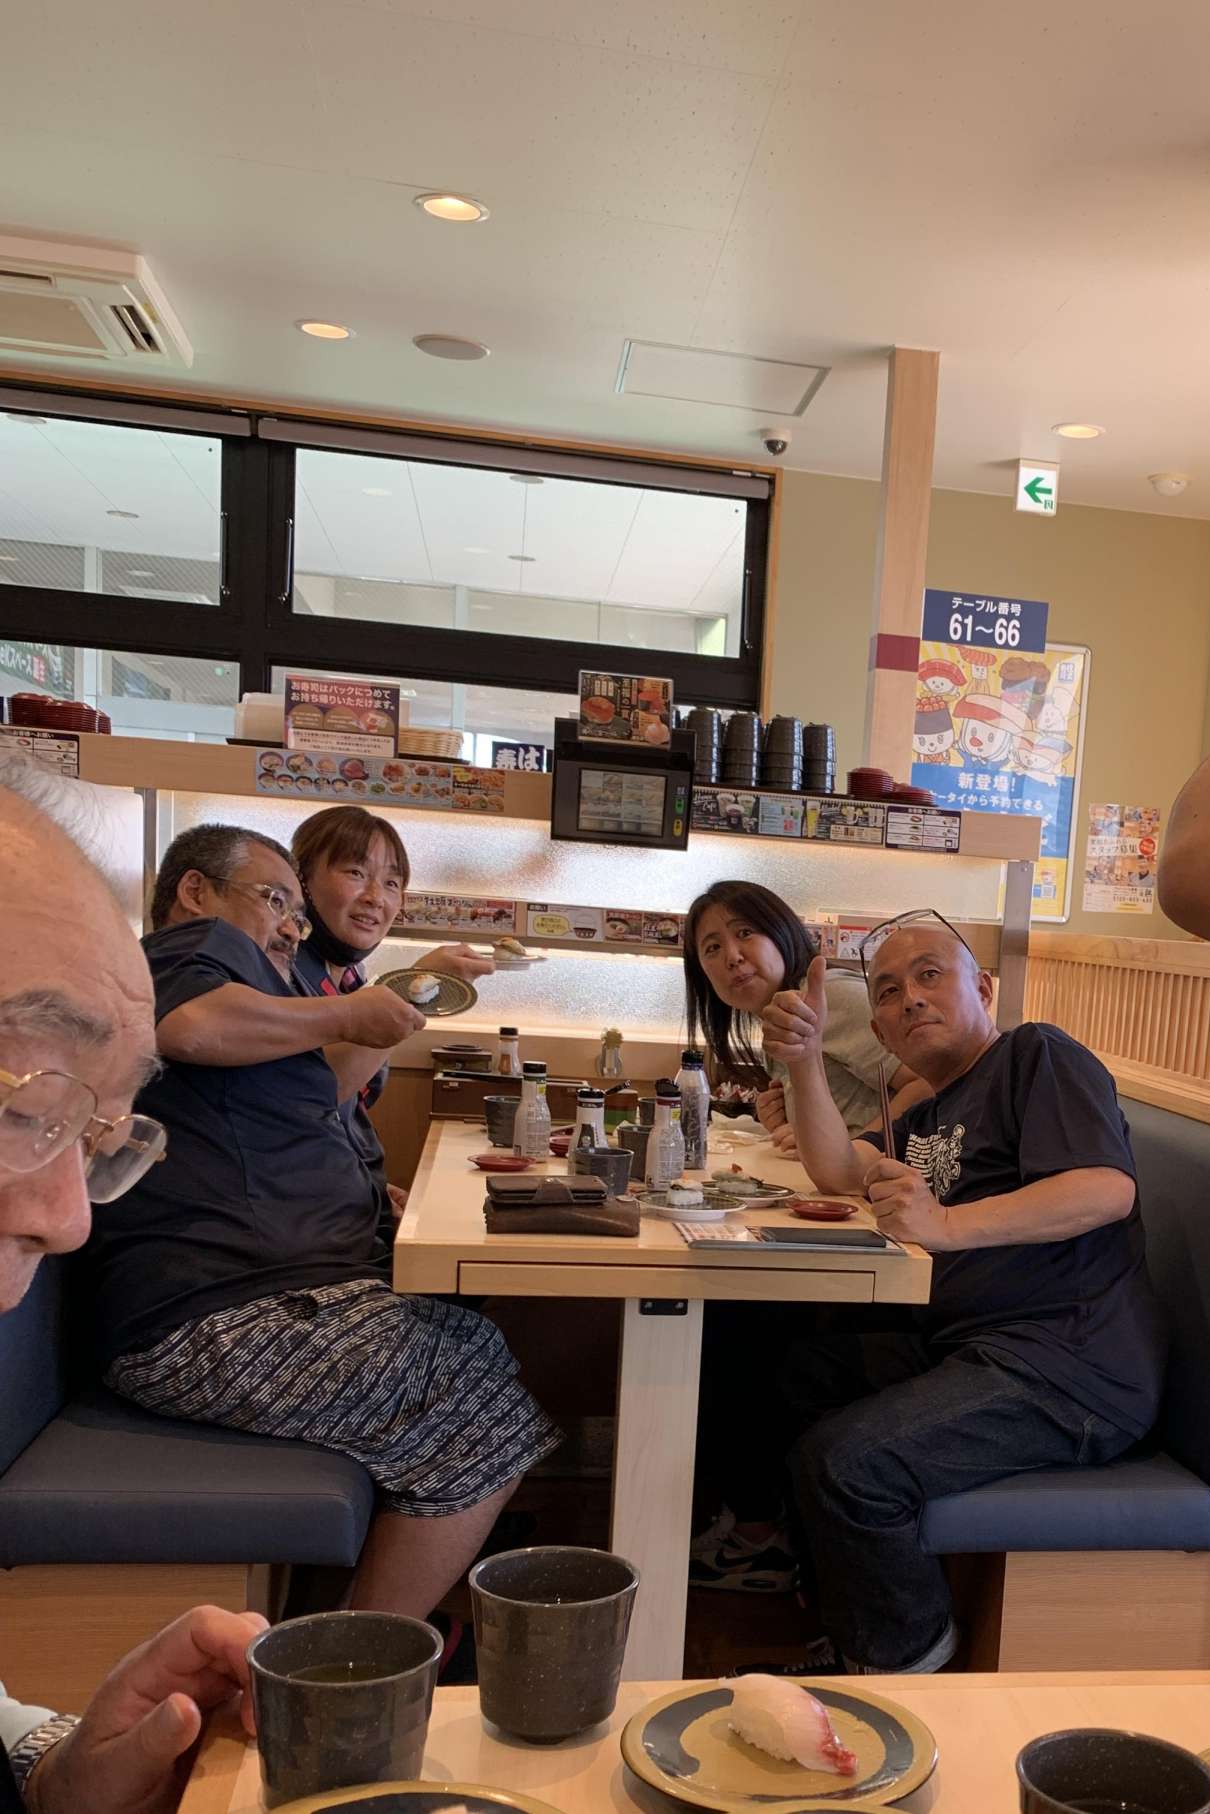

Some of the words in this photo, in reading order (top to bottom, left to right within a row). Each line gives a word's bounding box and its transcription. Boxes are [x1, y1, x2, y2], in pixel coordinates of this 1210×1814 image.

[951, 596, 1022, 617] テーブル番号
